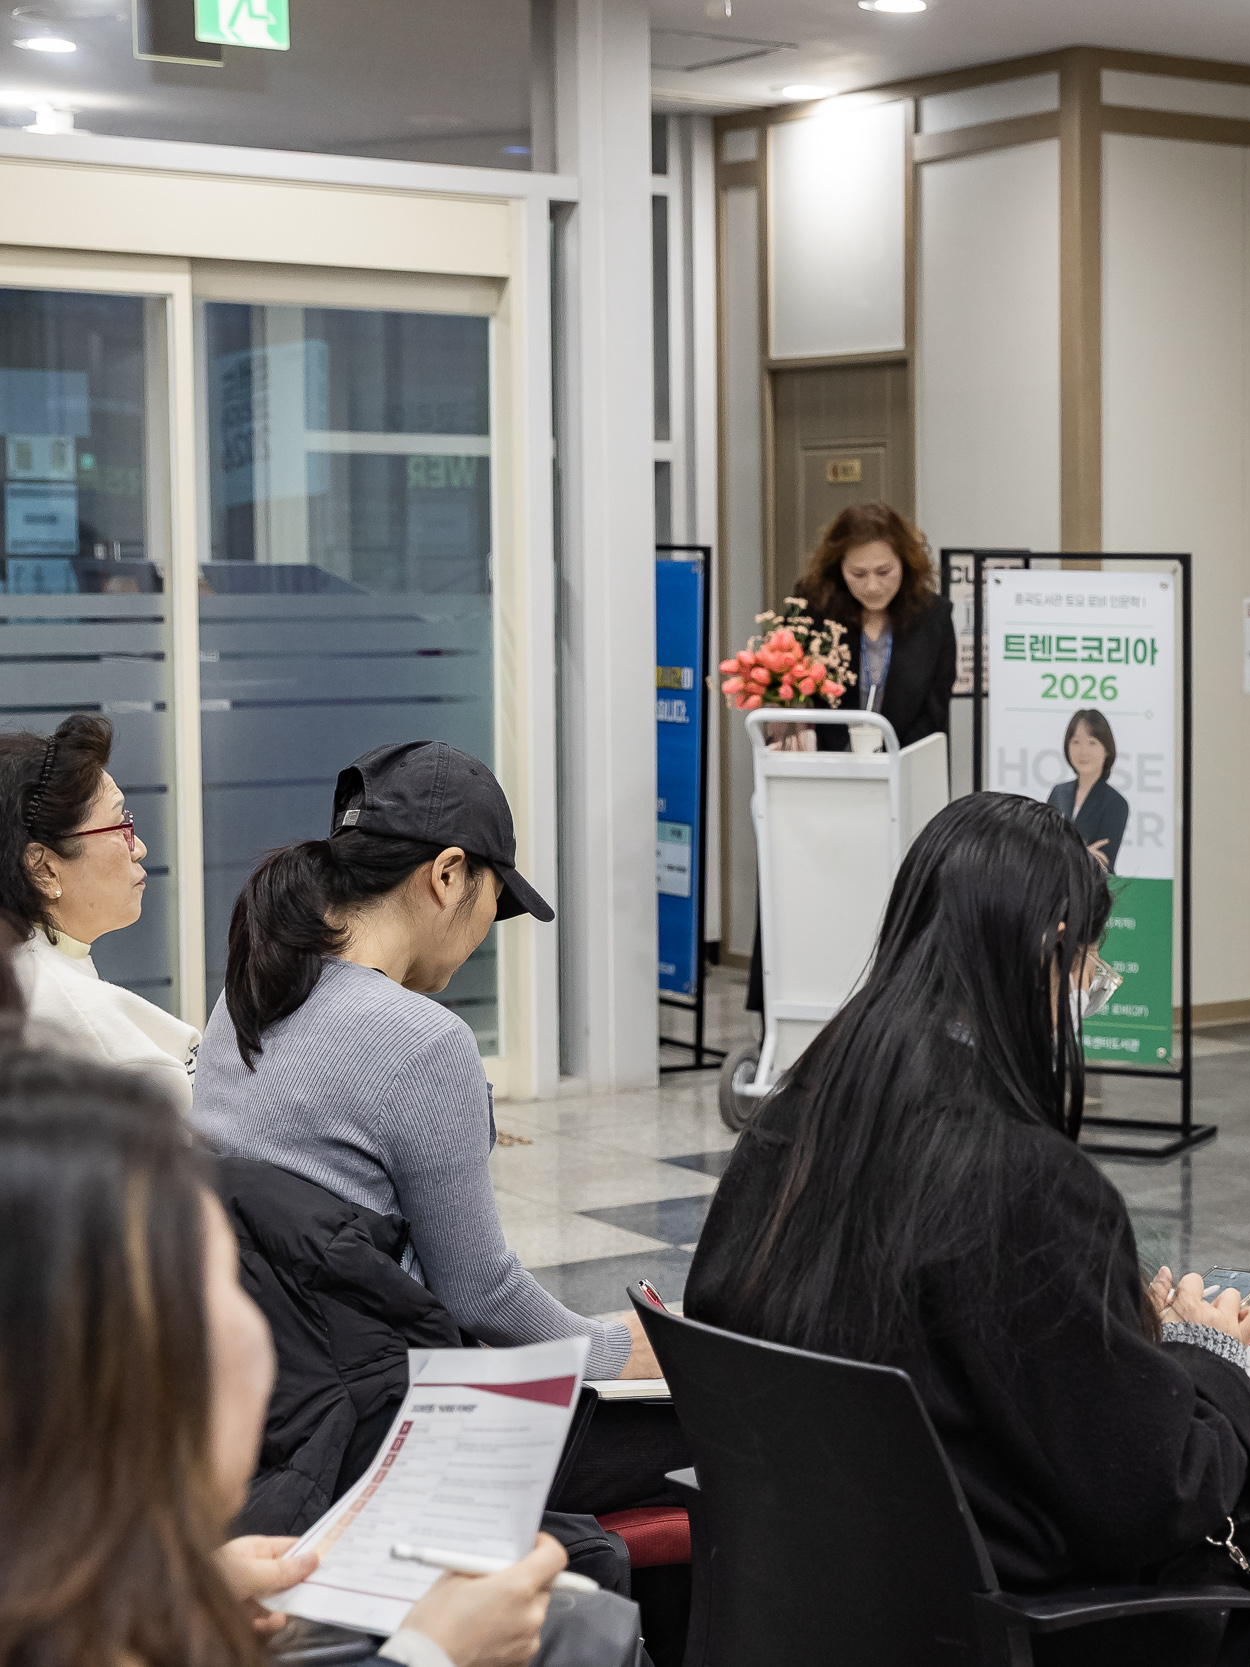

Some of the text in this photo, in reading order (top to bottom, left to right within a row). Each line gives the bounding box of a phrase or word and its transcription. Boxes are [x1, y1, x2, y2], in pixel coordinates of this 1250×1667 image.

[1003, 633, 1158, 666] 트렌드코리아
[1040, 673, 1118, 701] 2026
[997, 746, 1165, 794] HOSE
